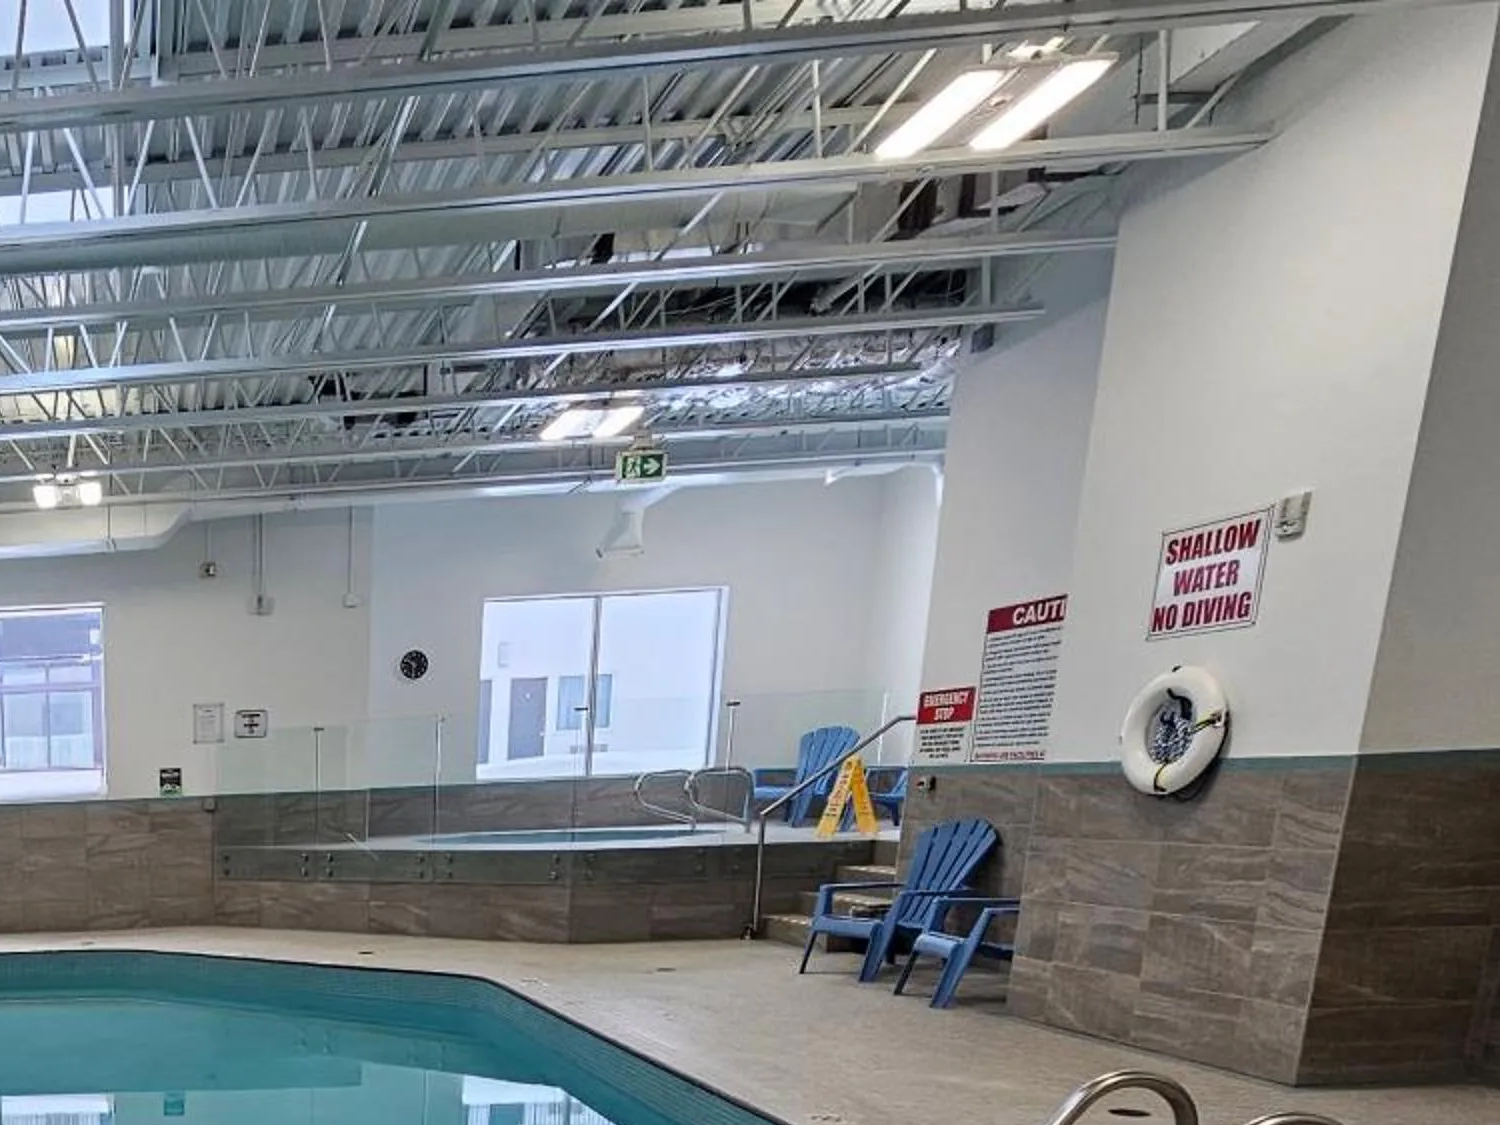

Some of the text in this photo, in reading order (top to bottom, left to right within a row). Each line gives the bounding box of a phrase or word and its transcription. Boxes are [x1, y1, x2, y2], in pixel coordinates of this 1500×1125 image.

[1165, 519, 1261, 565] SHALLOW
[1173, 559, 1240, 597] WATER
[1151, 591, 1252, 632] NO DIVING
[933, 707, 955, 721] STOP
